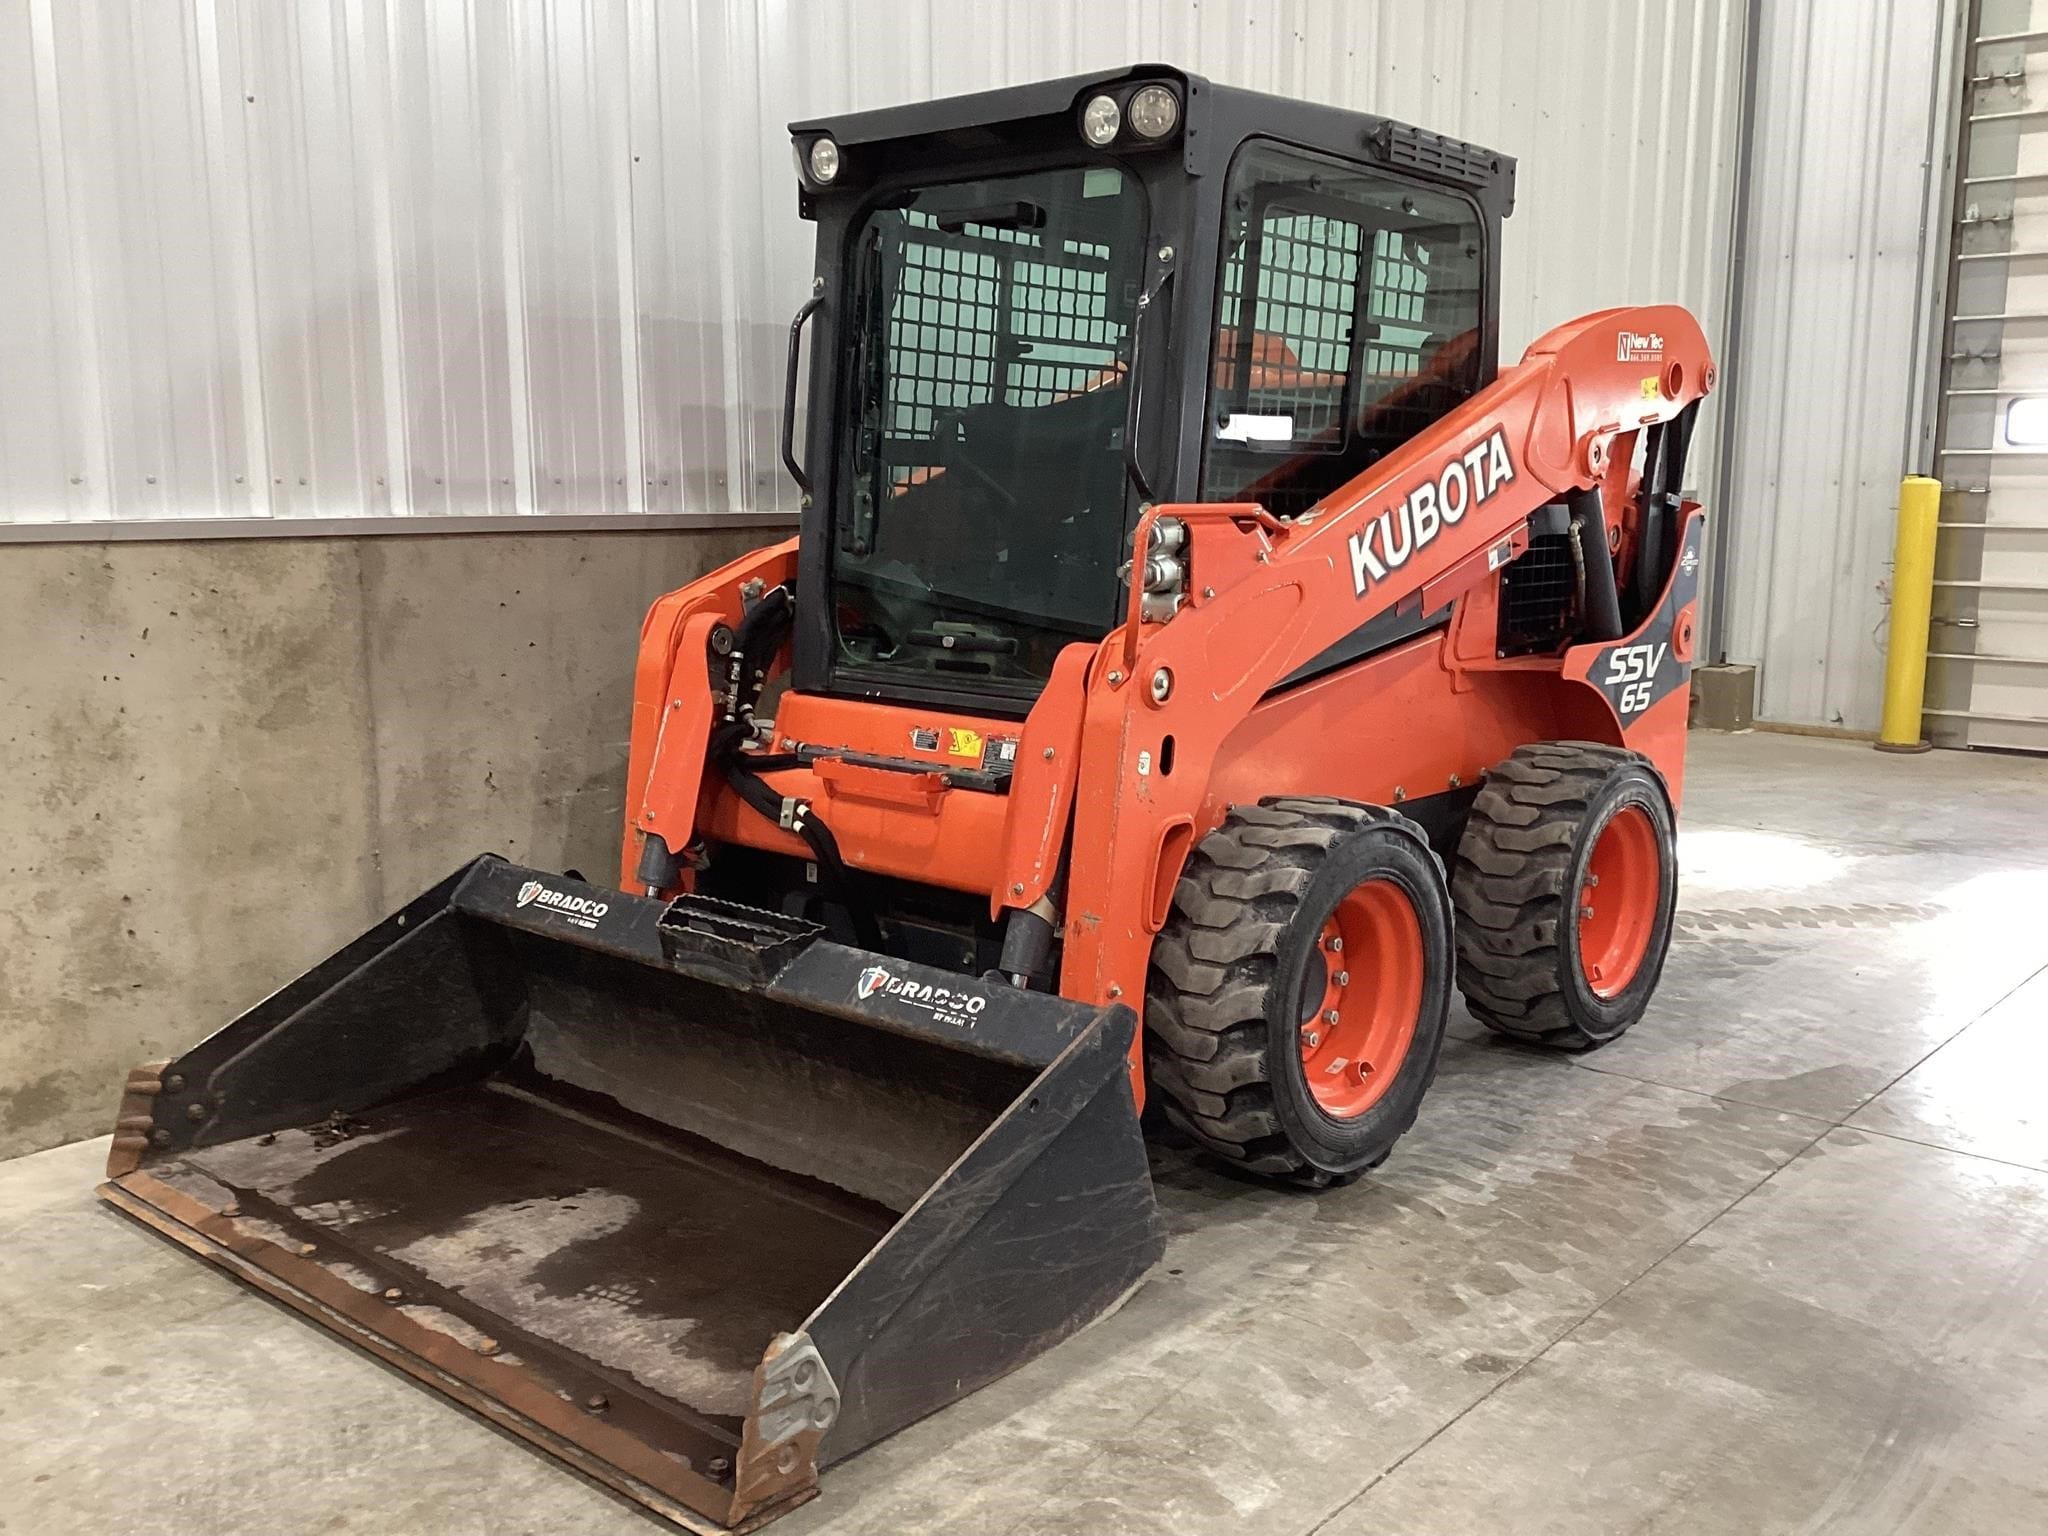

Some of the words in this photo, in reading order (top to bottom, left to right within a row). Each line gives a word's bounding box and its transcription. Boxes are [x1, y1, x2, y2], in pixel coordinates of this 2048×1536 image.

[1631, 333, 1649, 349] New
[1650, 333, 1664, 349] Tec
[1348, 431, 1514, 596] KUBOTA
[1604, 642, 1668, 685] SSV
[1620, 680, 1653, 714] 65
[537, 889, 609, 918] BRADCO
